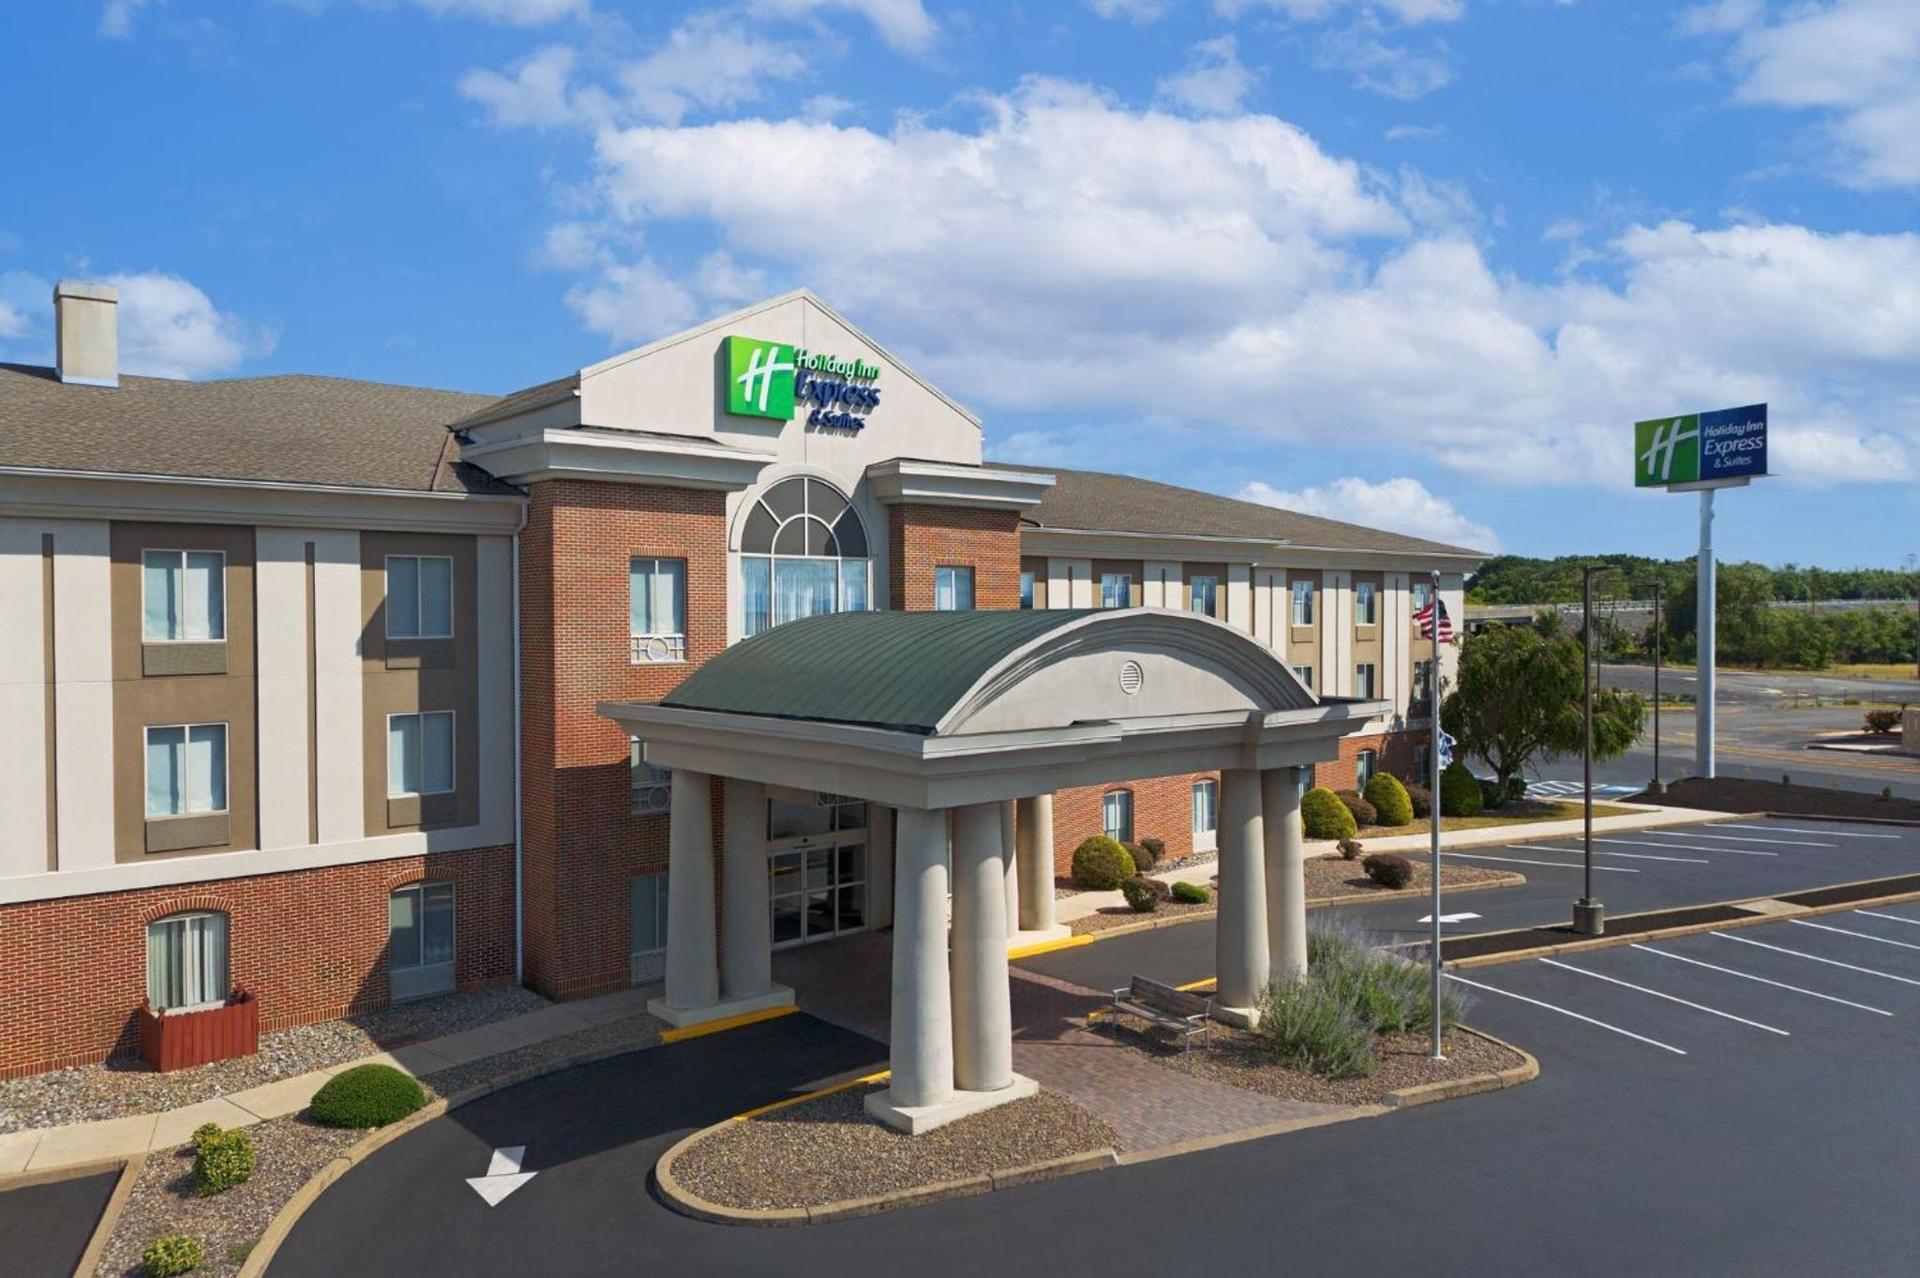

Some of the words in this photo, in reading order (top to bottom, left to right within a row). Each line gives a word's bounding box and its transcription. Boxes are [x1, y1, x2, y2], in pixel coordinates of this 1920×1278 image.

[796, 349, 856, 379] Holiday
[857, 359, 880, 379] Inn
[737, 346, 795, 412] H
[795, 371, 881, 407] Express
[809, 410, 821, 427] &
[822, 412, 866, 431] Suites
[1704, 424, 1745, 438] Holiday
[1746, 420, 1764, 432] Inn
[1640, 419, 1699, 480] H
[1704, 437, 1764, 457] Express
[1713, 460, 1722, 469] &
[1723, 456, 1752, 468] Suites
